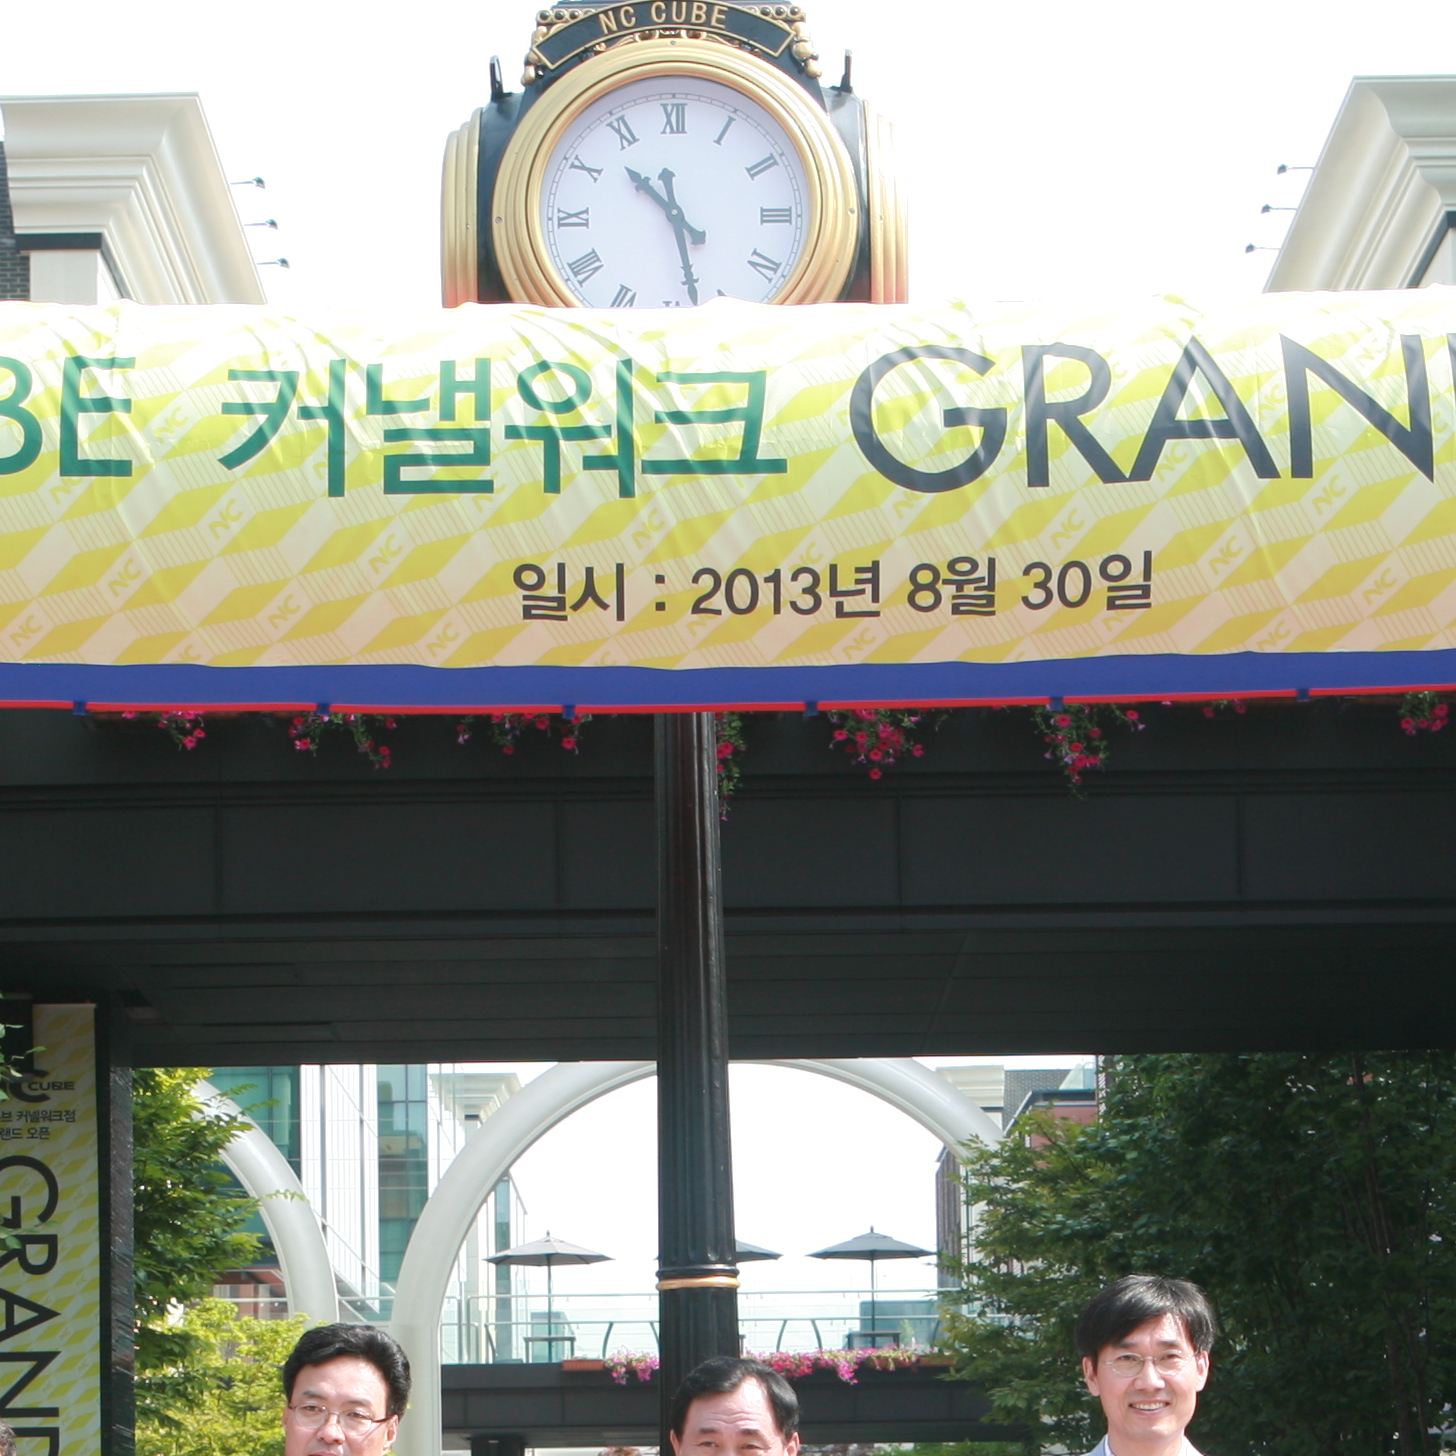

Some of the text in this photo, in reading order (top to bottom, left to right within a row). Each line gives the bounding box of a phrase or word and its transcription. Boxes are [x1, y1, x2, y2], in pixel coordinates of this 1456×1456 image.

[598, 2, 729, 36] NC CUBE
[606, 114, 640, 151] XI
[660, 103, 687, 134] XII
[568, 154, 604, 183] X
[745, 153, 779, 181] II
[557, 207, 590, 229] IX
[760, 206, 792, 225] III
[1357, 332, 1394, 366] NC
[1258, 384, 1288, 421] NC
[154, 406, 189, 443] NC
[218, 356, 788, 499] 커낼워크
[1157, 449, 1189, 482] NC
[1312, 474, 1347, 515] NC
[207, 500, 244, 539] NC
[632, 508, 669, 548] NC
[1050, 508, 1087, 548] NC
[367, 533, 404, 575] NC
[789, 542, 825, 576] NC
[1207, 536, 1244, 575] NC
[107, 557, 144, 598] NC
[513, 561, 626, 622] 일시
[690, 558, 882, 618] 2013년
[907, 556, 997, 618] 8월
[1020, 550, 1153, 611] 30일
[1362, 567, 1399, 605] NC
[267, 594, 302, 630] NC
[9, 614, 44, 647] NC
[426, 622, 461, 656] NC
[844, 628, 878, 660] NC
[1257, 620, 1292, 651] NC
[28, 1081, 76, 1091] CUBE
[26, 1126, 51, 1140] 오픈
